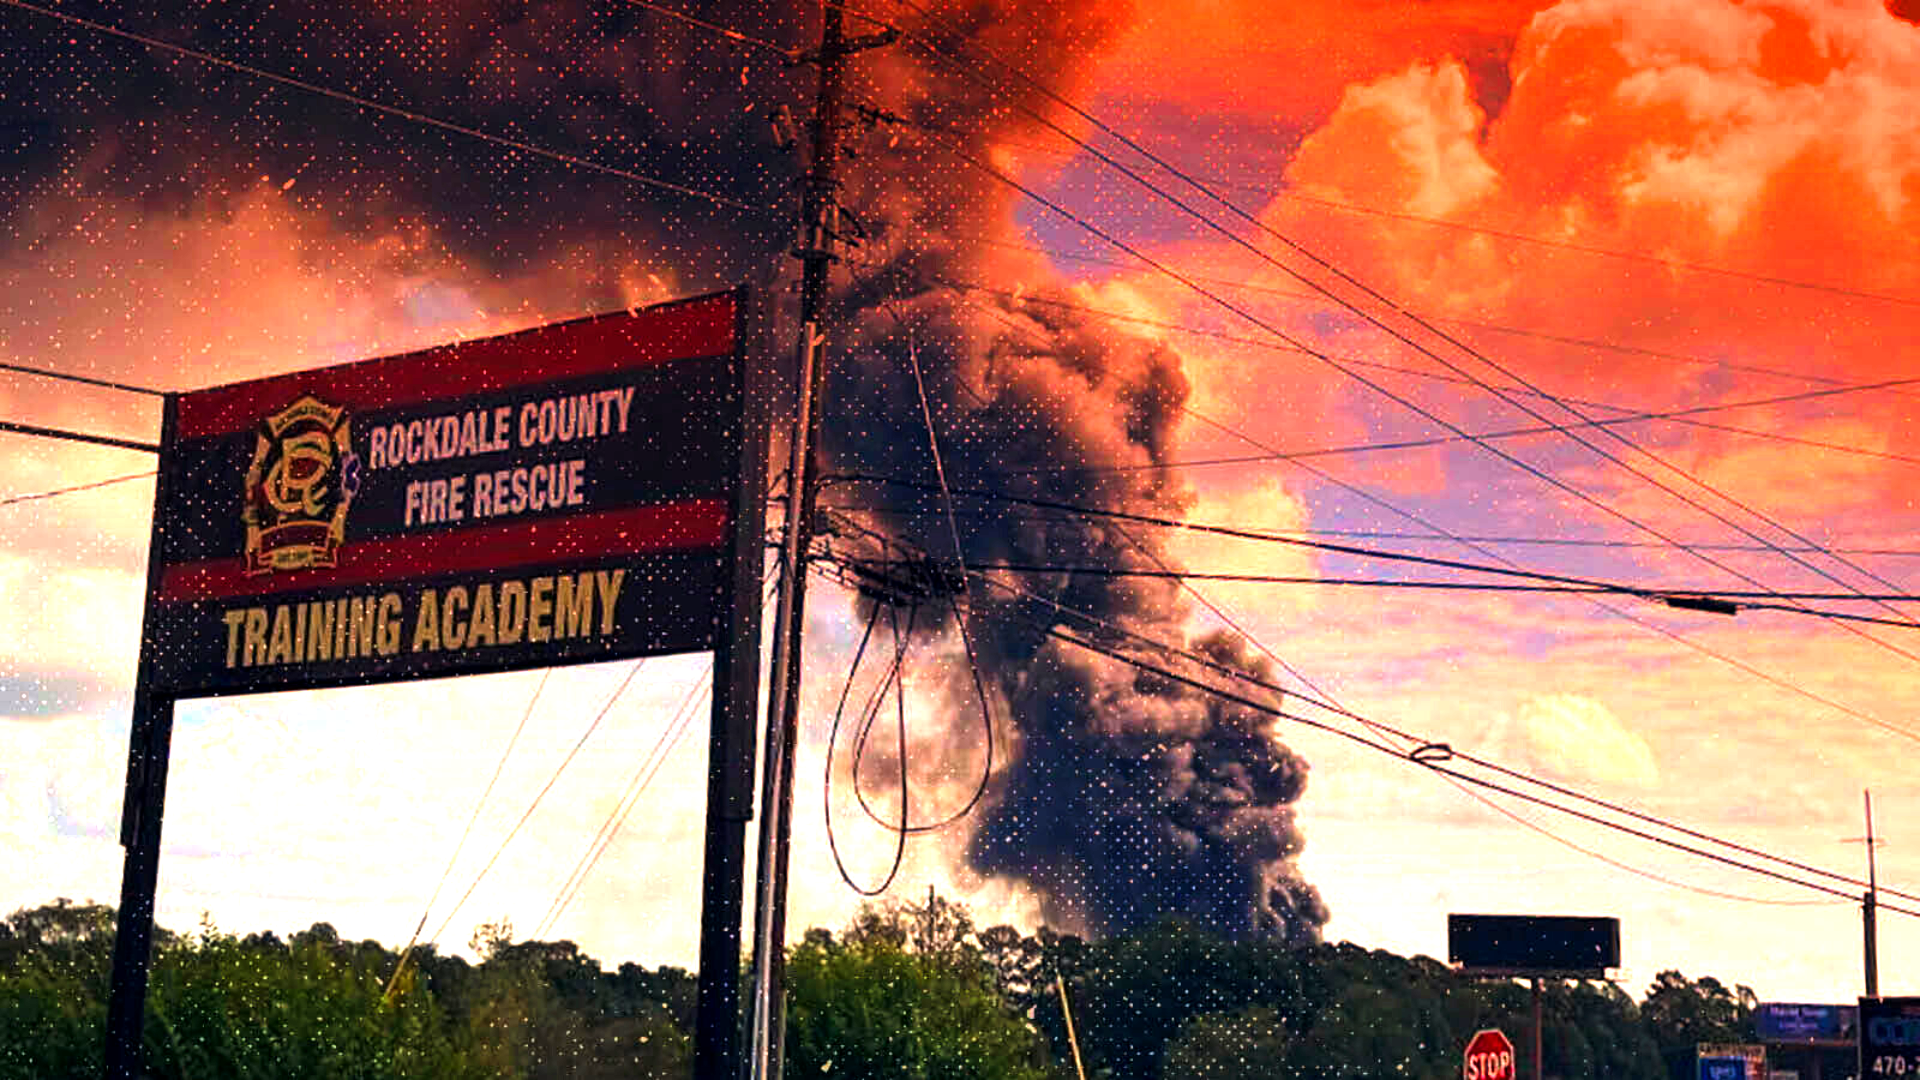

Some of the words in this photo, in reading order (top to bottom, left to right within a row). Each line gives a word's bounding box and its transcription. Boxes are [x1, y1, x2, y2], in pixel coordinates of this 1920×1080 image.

[370, 408, 512, 469] ROCKDALE
[520, 387, 635, 448] COUNTY
[404, 477, 465, 527] FIRE
[474, 460, 586, 517] RESCUE
[224, 593, 403, 668] TRAINING
[414, 569, 626, 653] ACADEMY
[1468, 1051, 1510, 1080] STOP
